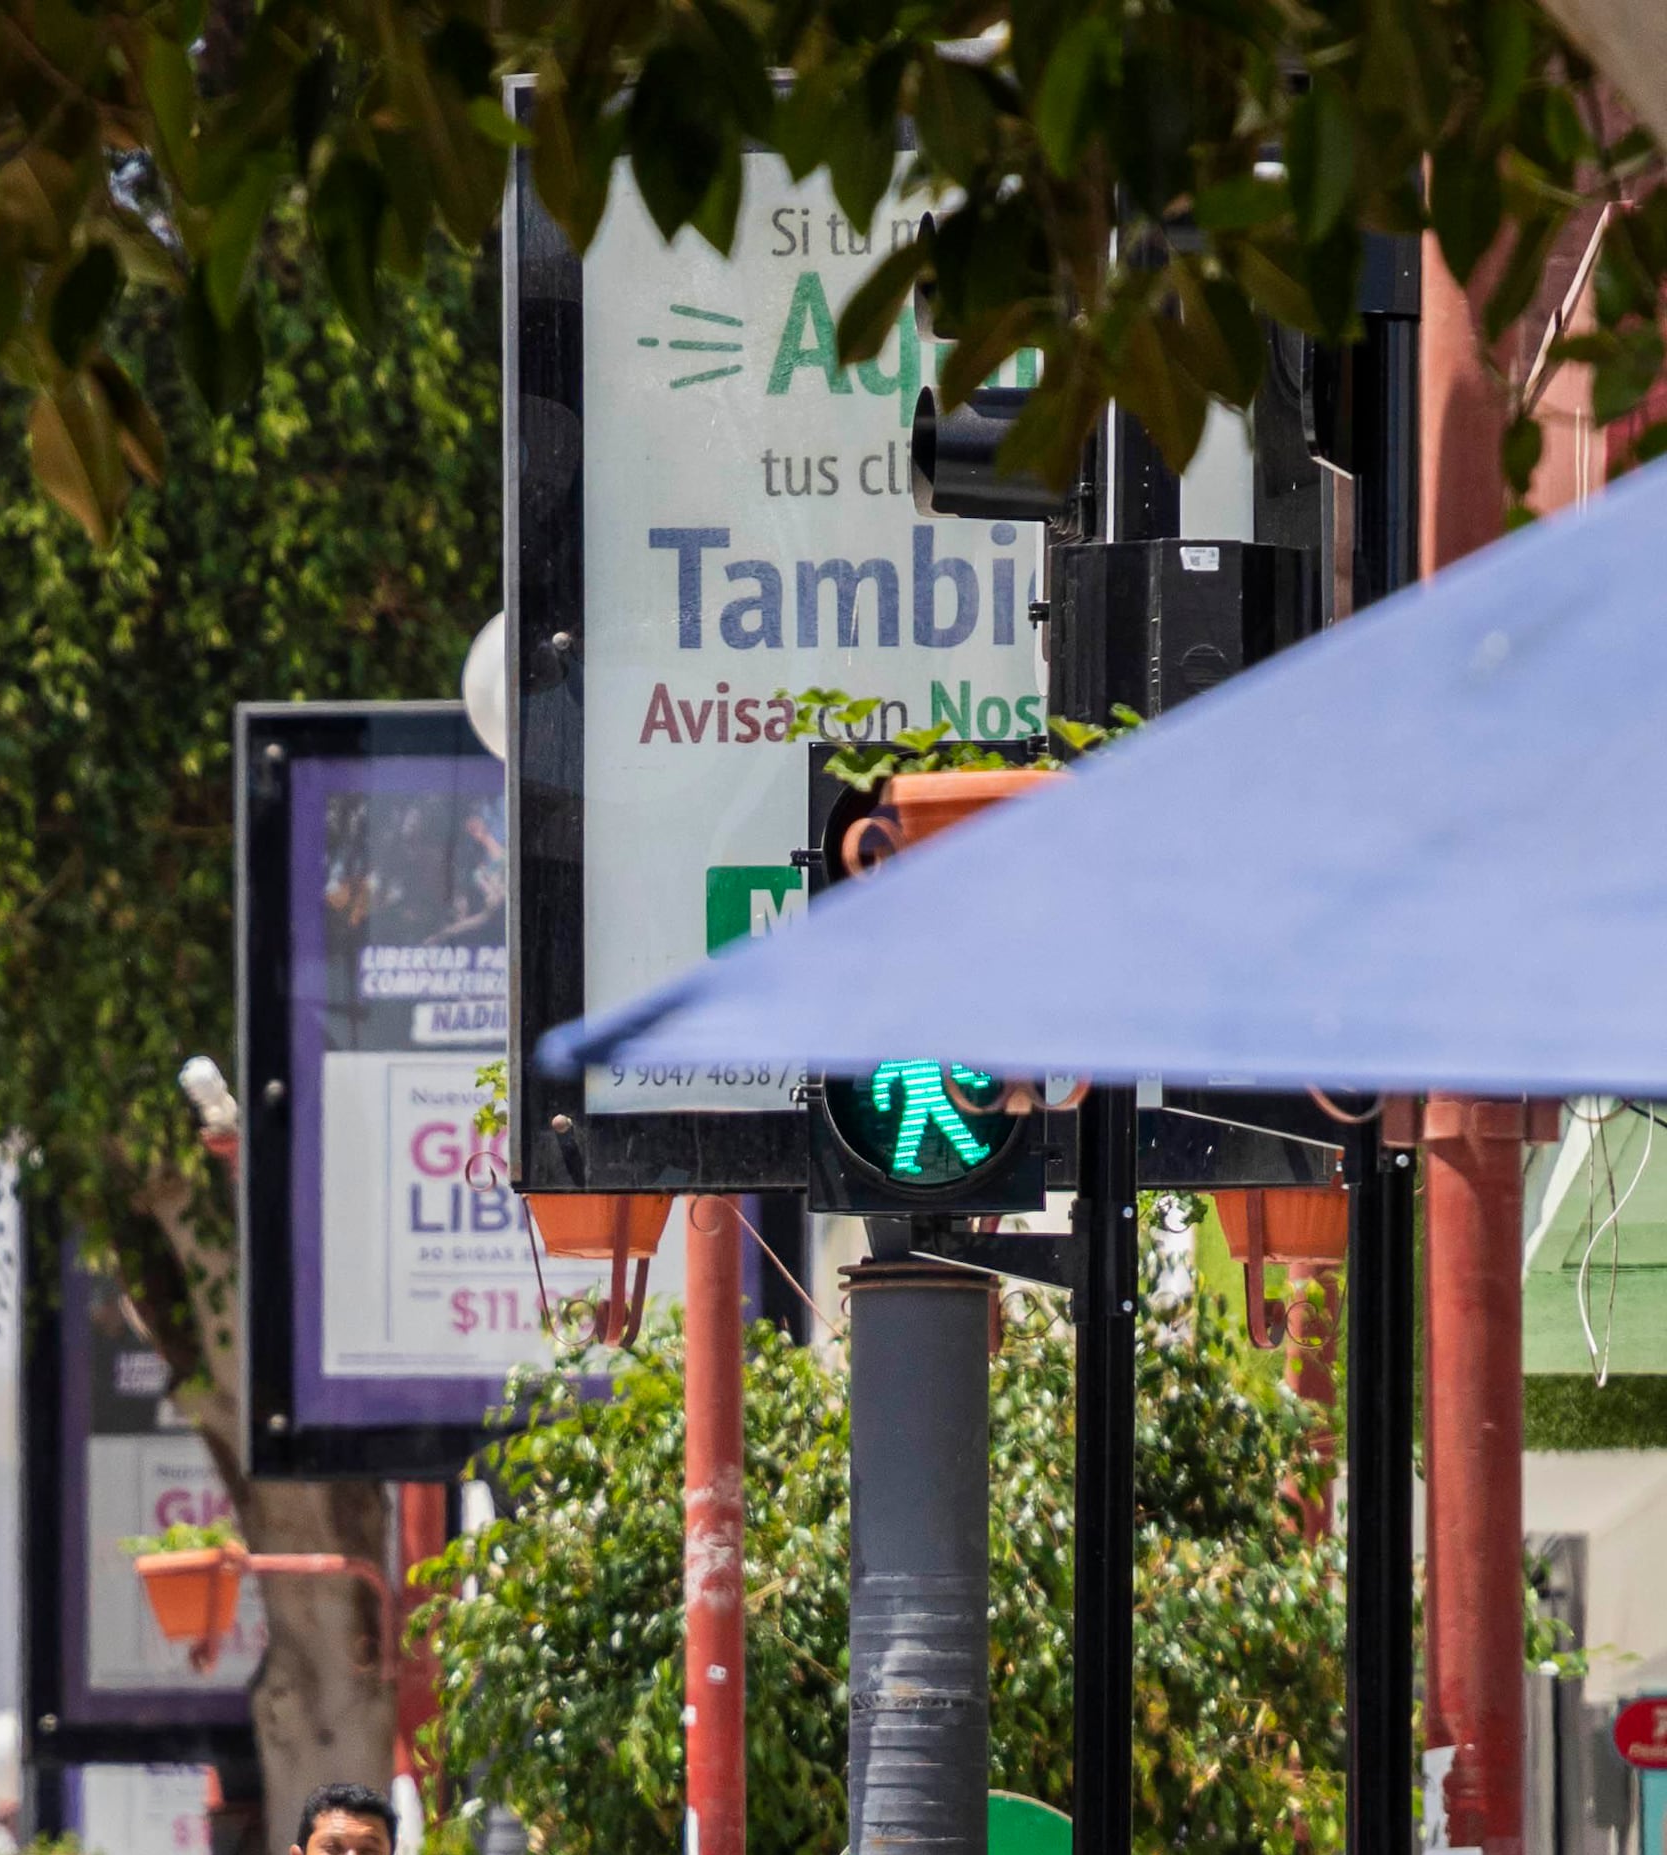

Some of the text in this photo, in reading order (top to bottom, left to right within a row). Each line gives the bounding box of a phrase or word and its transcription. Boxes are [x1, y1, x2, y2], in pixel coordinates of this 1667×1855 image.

[770, 206, 811, 257] Si
[826, 211, 873, 256] tu
[760, 440, 913, 497] tus cli
[649, 523, 1044, 651] Tambi
[639, 681, 796, 744] Avisa
[930, 679, 1043, 741] Nos
[750, 888, 805, 938] M
[475, 945, 507, 970] PA
[410, 1088, 494, 1106] Nuevo
[410, 1120, 508, 1178] GI
